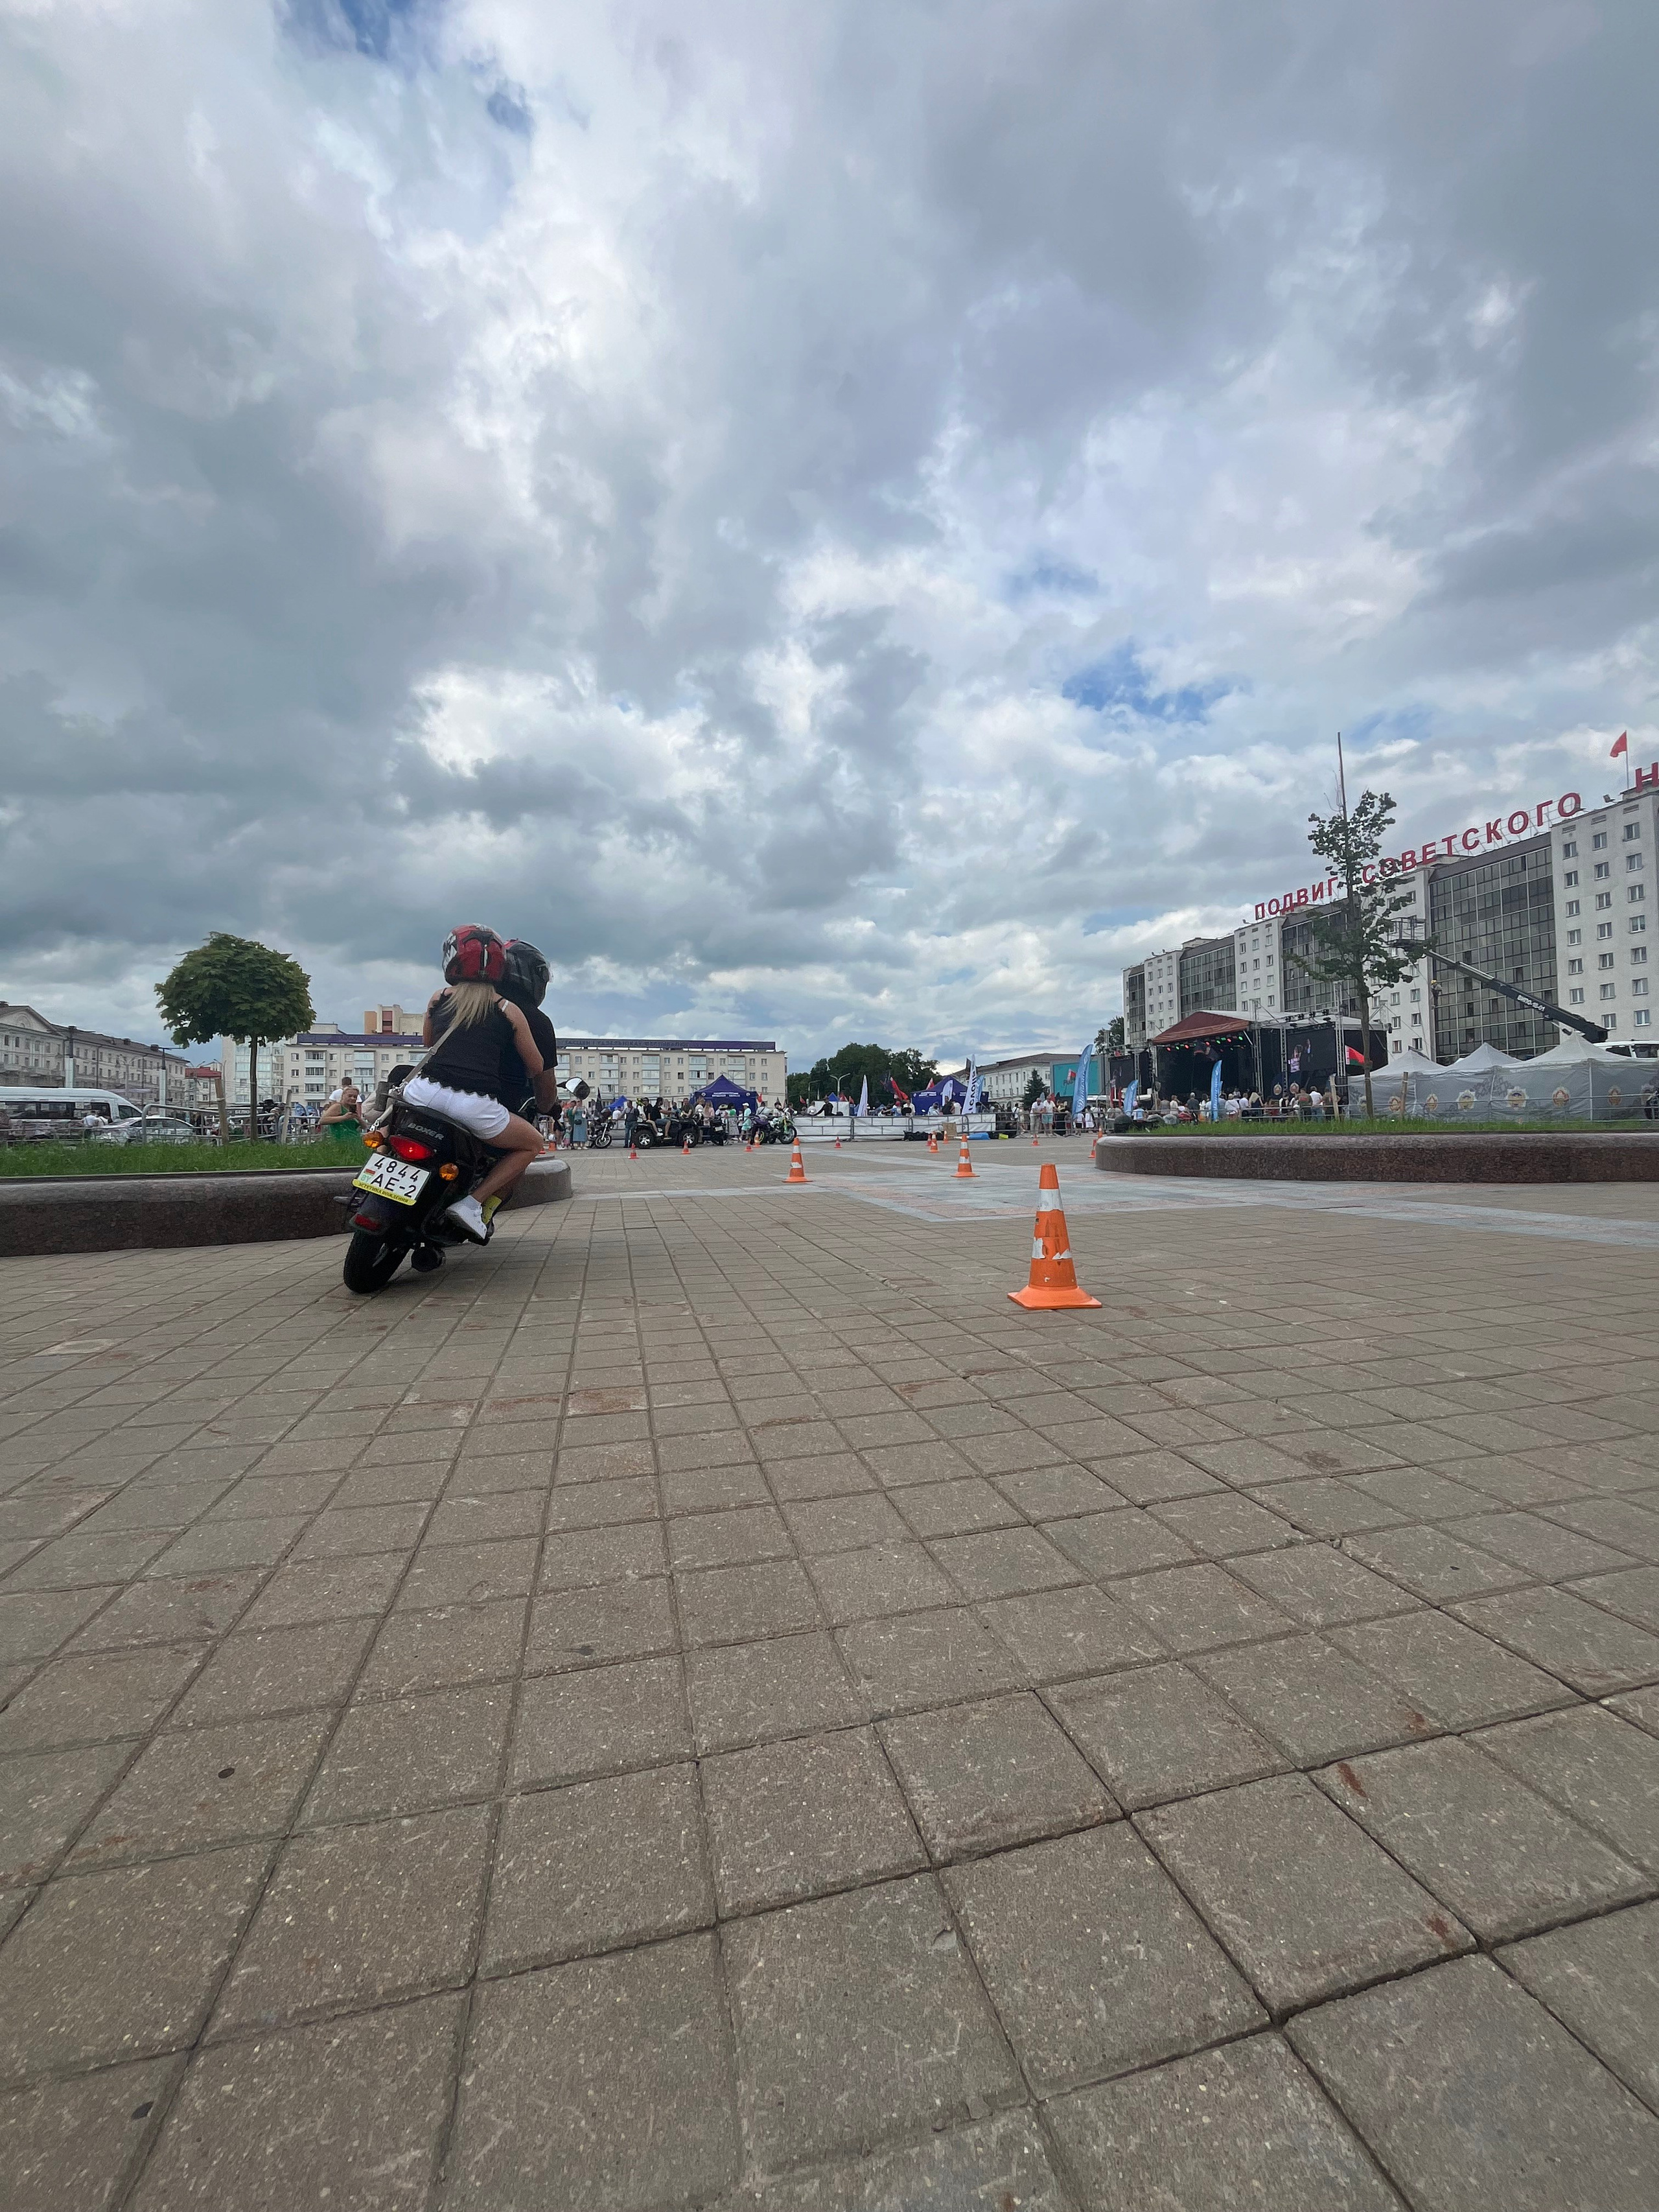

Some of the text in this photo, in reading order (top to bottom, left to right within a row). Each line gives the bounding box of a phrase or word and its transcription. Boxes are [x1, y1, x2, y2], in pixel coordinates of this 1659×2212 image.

[1255, 876, 1338, 920] ПОДВИГ
[1362, 792, 1581, 883] СОВЕТСКОГО
[408, 1123, 445, 1140] BOXER
[374, 1157, 421, 1182] 4844
[371, 1173, 417, 1198] AE-2
